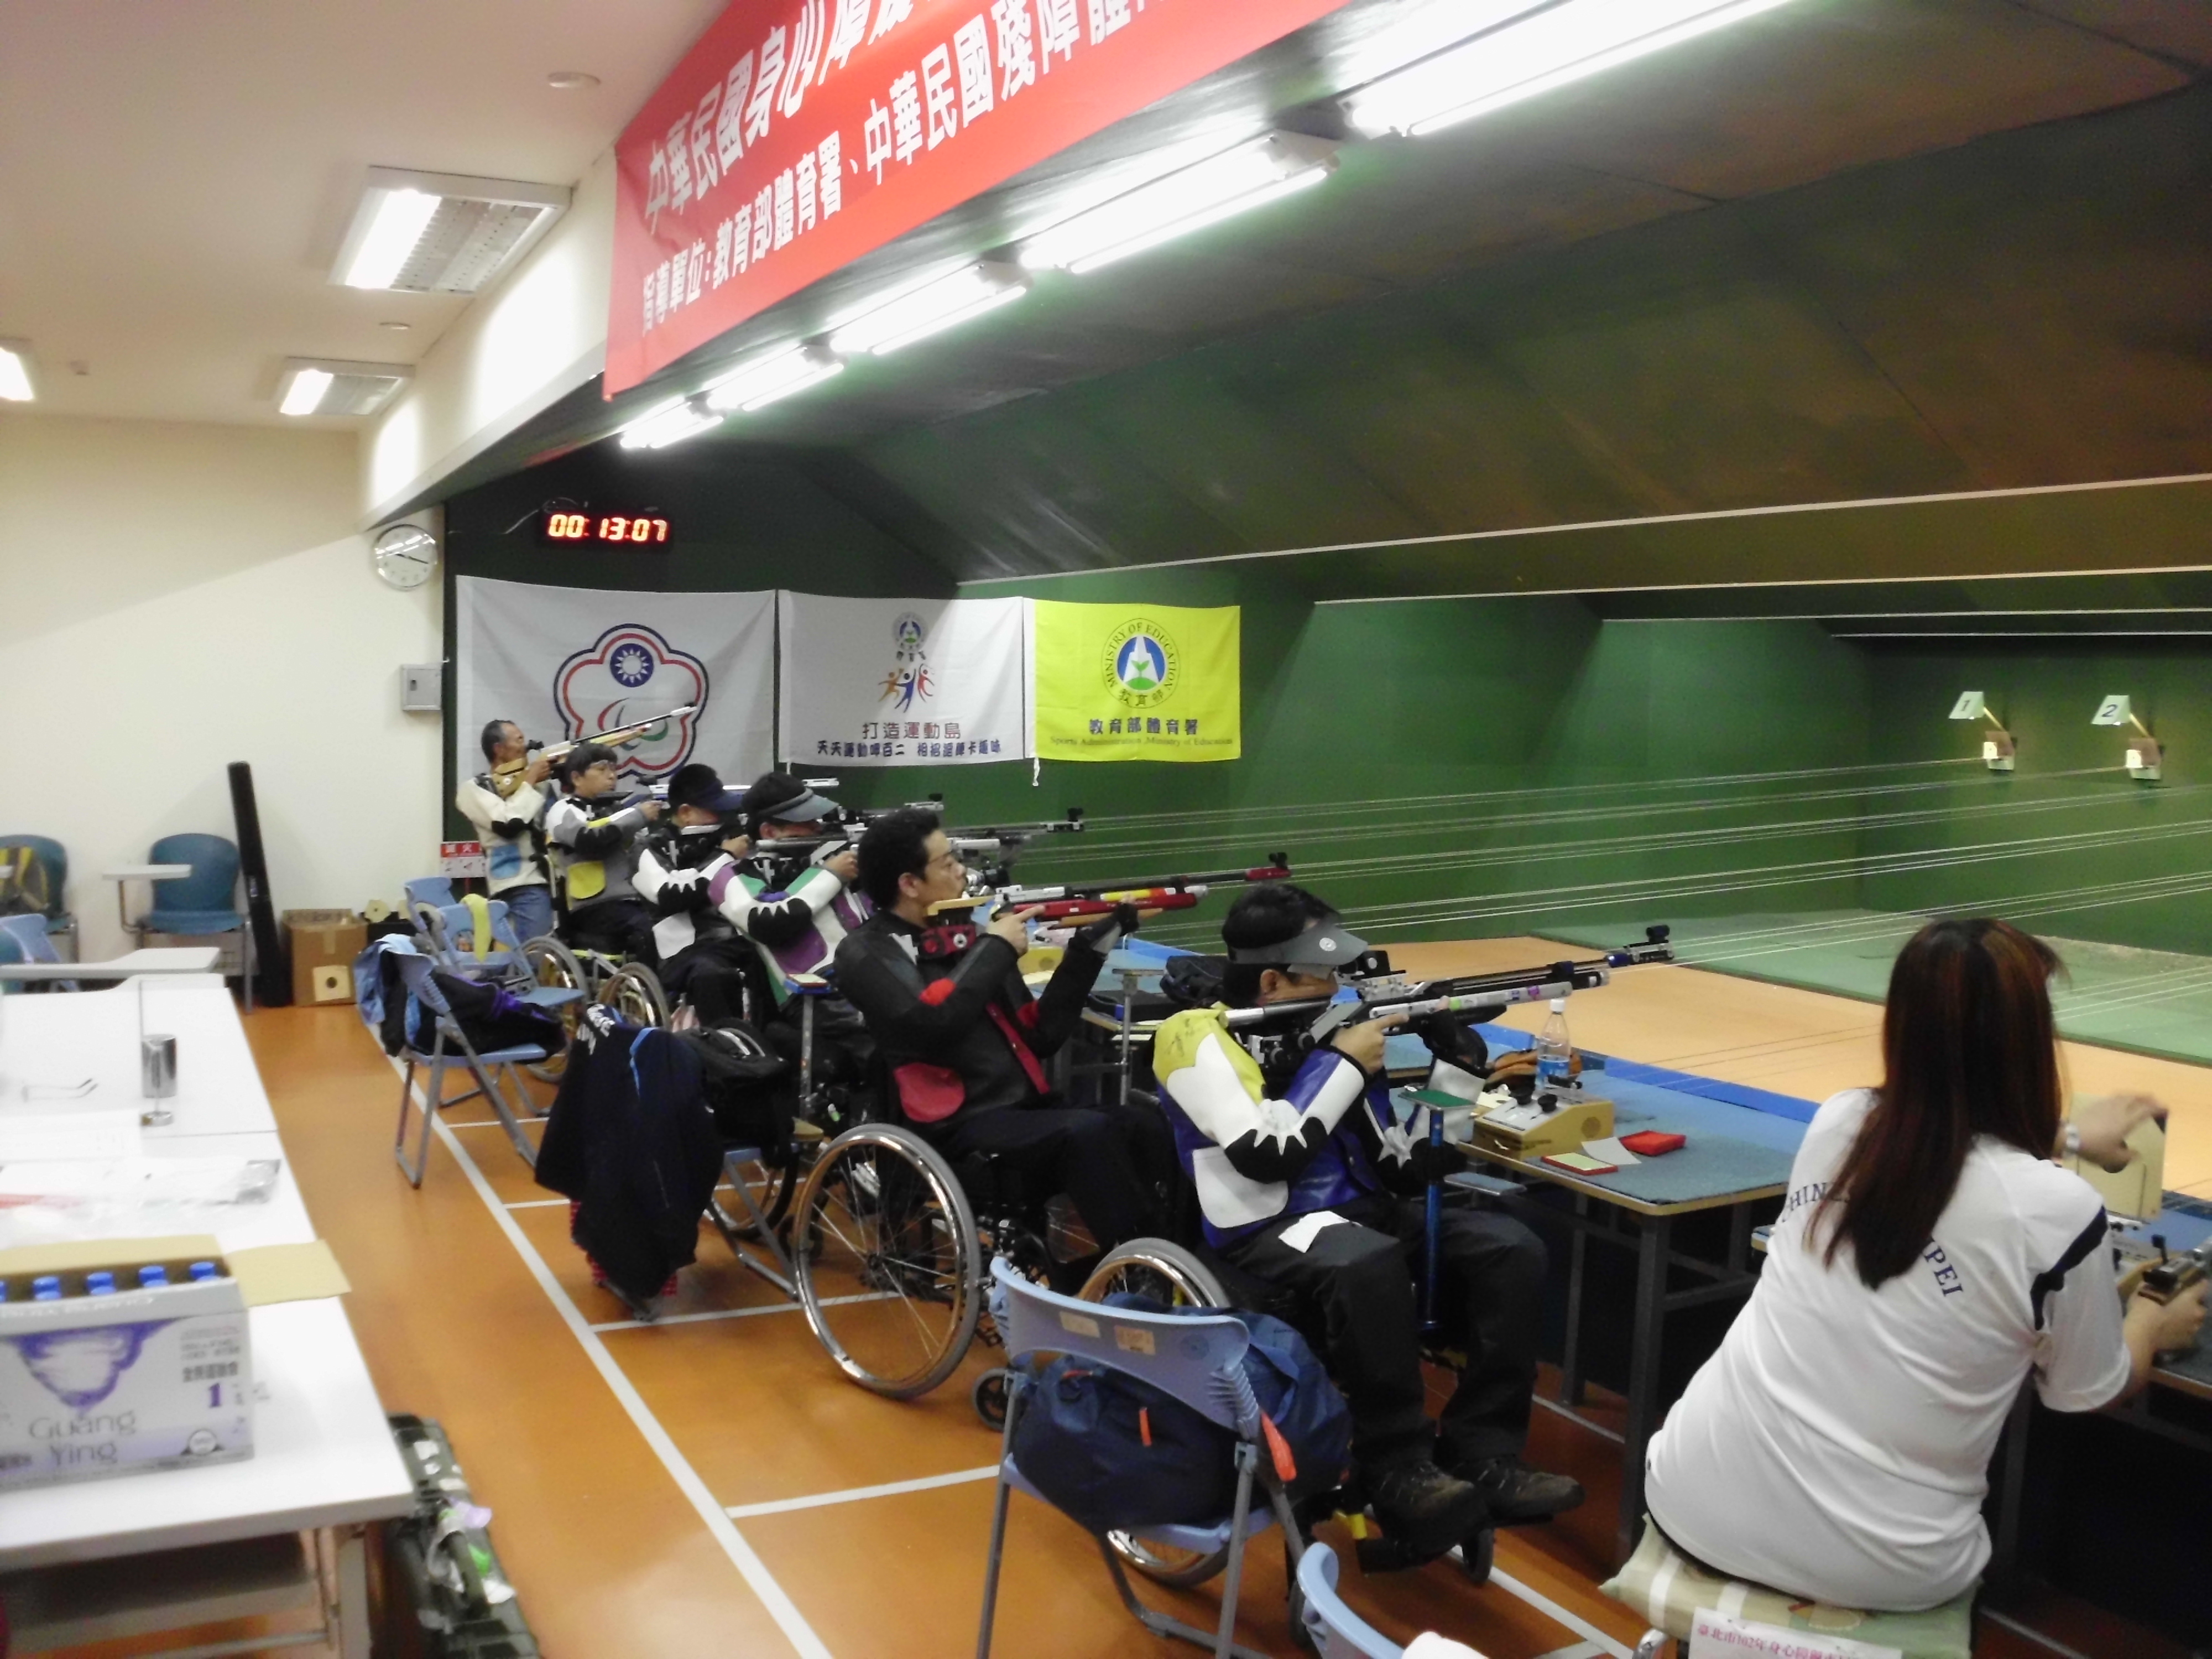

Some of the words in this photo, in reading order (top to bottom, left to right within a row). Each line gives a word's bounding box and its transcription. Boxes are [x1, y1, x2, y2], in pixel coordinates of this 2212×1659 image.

[549, 514, 667, 542] 00:13:07
[1105, 629, 1126, 687] MINISTRY
[1128, 622, 1142, 634] OF
[1145, 624, 1177, 690] EDUCATION
[1960, 699, 1971, 712] 1
[2101, 703, 2118, 718] 2
[862, 722, 961, 739] 打造運動島
